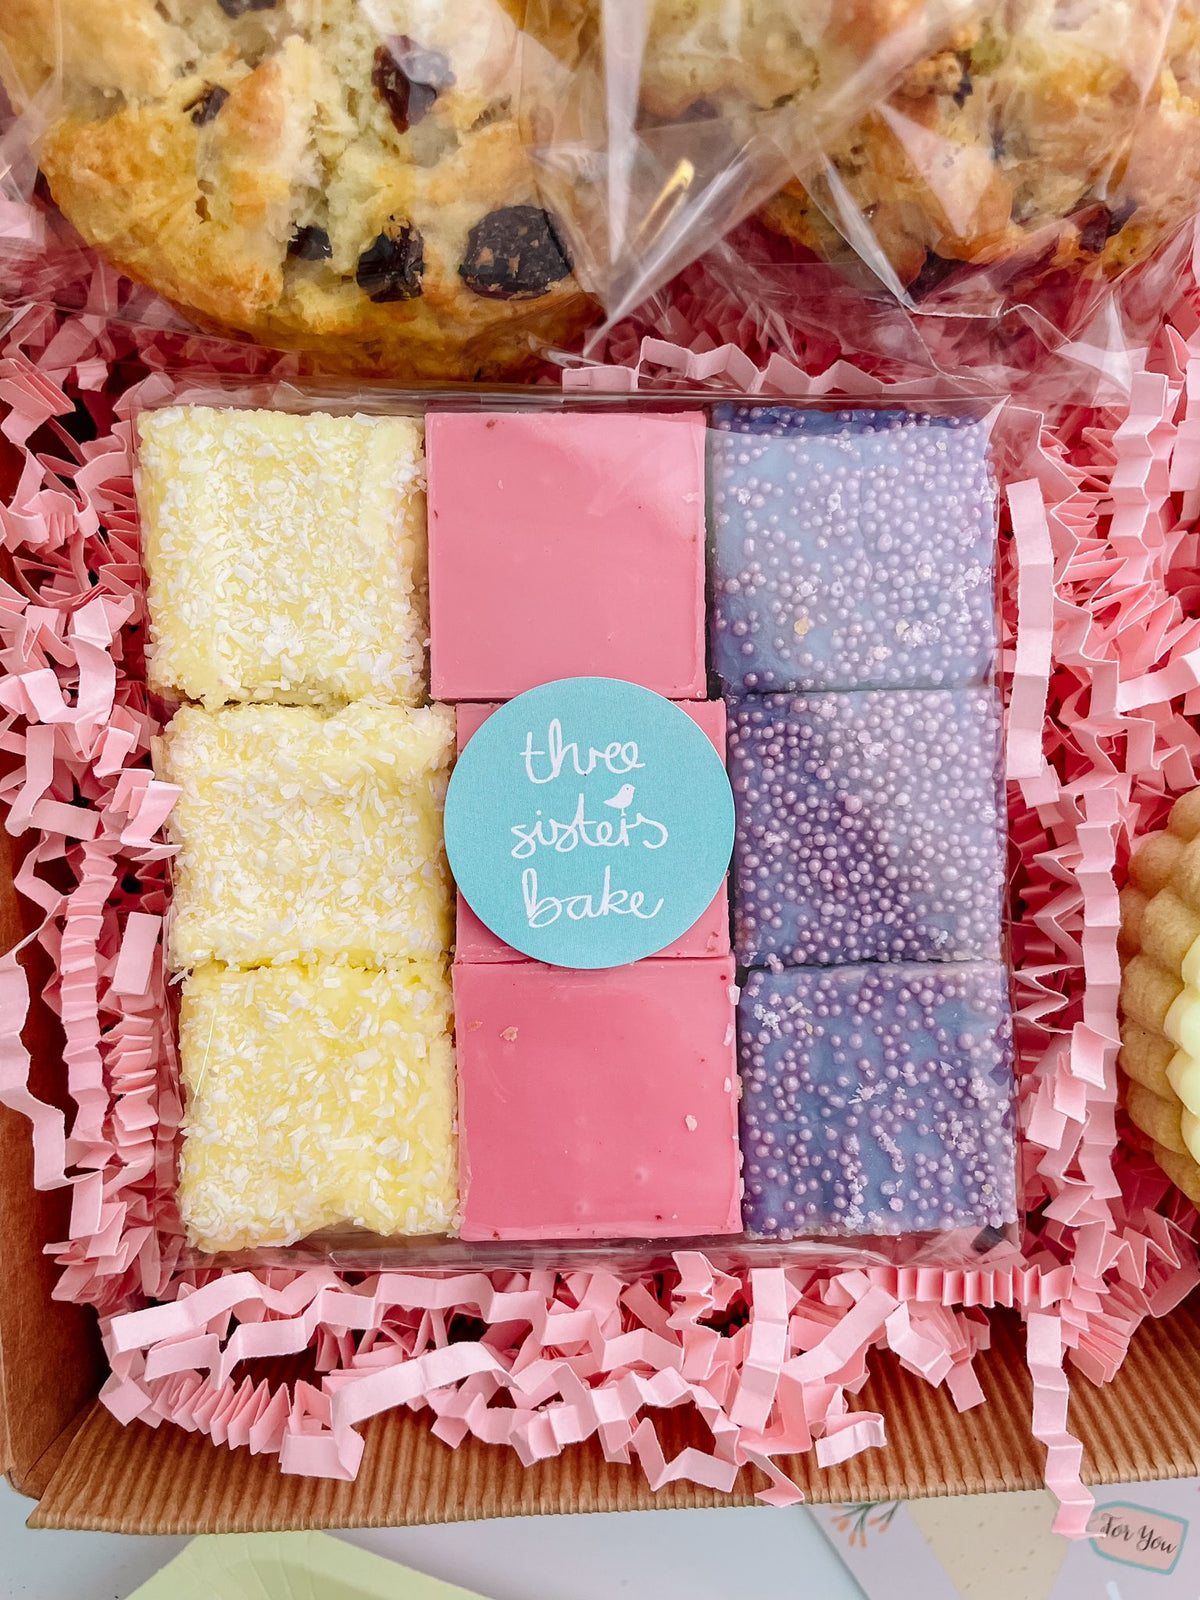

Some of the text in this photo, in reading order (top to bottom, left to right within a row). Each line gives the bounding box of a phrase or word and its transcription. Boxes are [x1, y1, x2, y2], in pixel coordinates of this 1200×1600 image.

[519, 718, 646, 784] three
[510, 792, 669, 860] sisters
[521, 865, 665, 929] bake
[1100, 1512, 1177, 1554] For You
